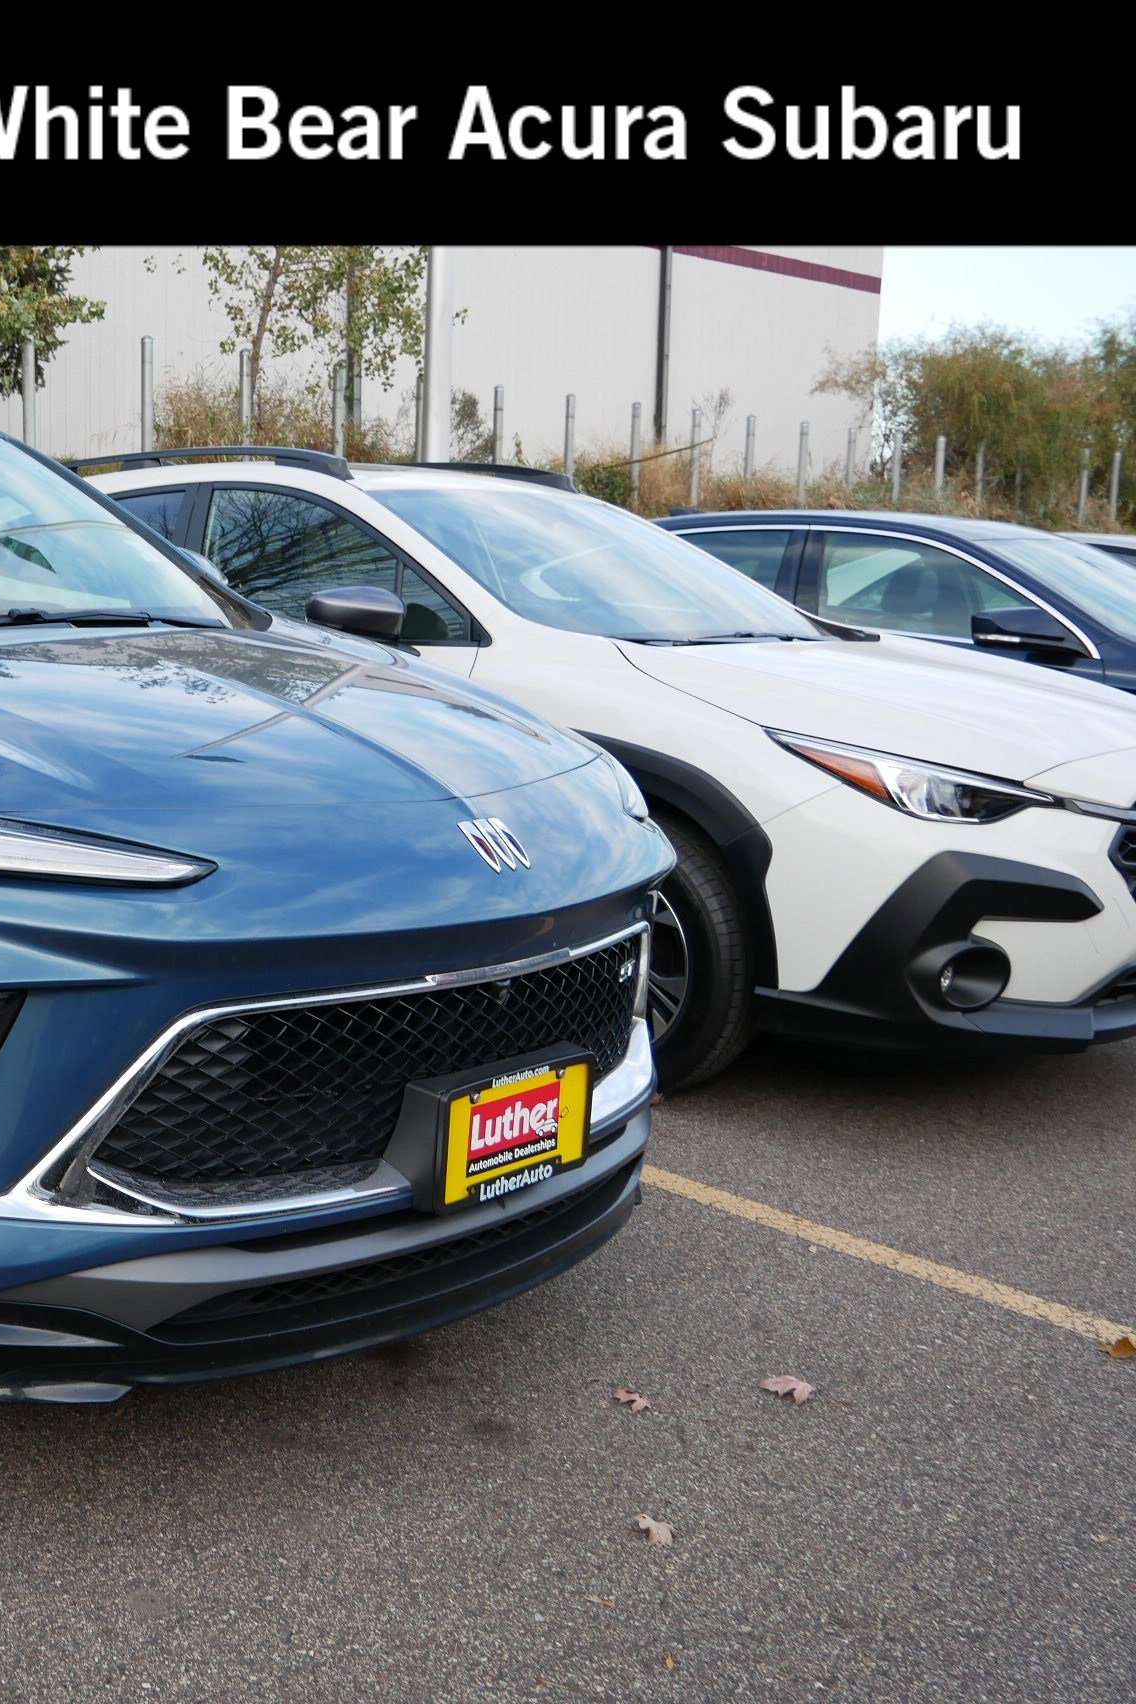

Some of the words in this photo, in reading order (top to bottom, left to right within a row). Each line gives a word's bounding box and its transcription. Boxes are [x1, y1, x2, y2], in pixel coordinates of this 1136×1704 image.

[491, 1065, 550, 1088] LutherAuto.com
[470, 1097, 559, 1151] Luther
[468, 1150, 513, 1173] Automobile
[514, 1138, 556, 1160] Dealerships
[479, 1162, 553, 1202] LutherAuto
